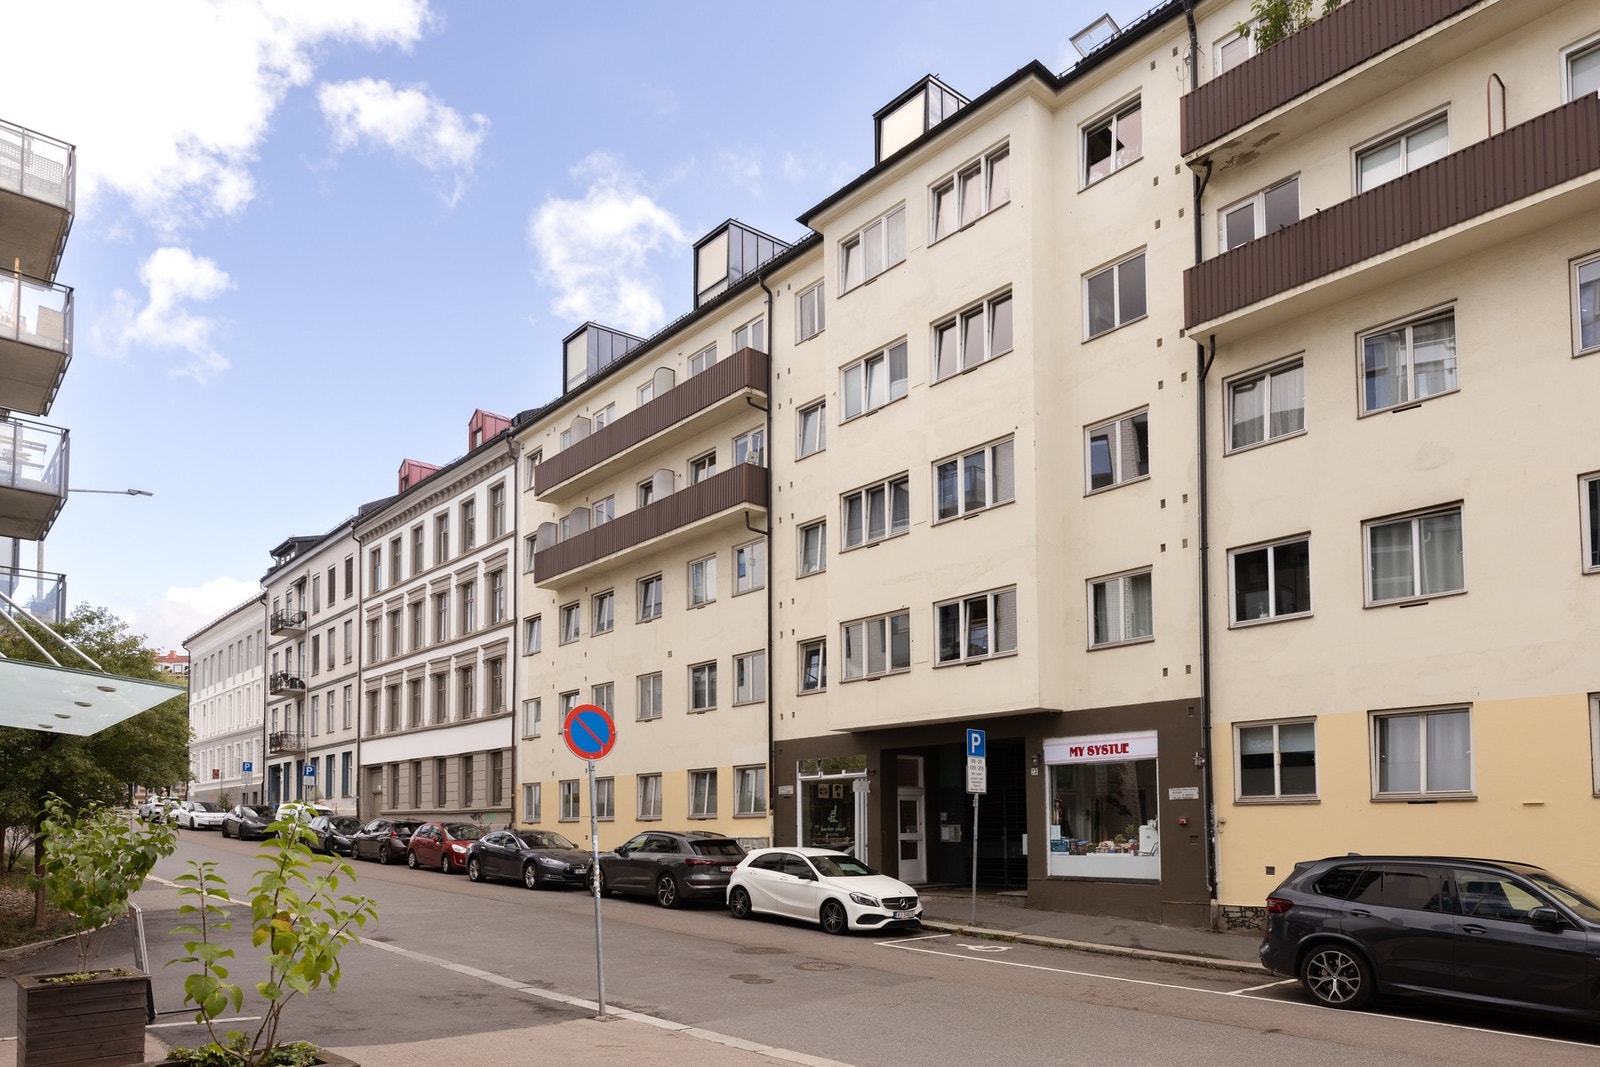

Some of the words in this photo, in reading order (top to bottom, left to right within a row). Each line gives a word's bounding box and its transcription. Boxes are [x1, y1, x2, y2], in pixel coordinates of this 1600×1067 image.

[972, 733, 981, 753] P
[1070, 746, 1085, 758] MY
[1088, 743, 1129, 756] SYSTUE
[306, 766, 313, 774] P
